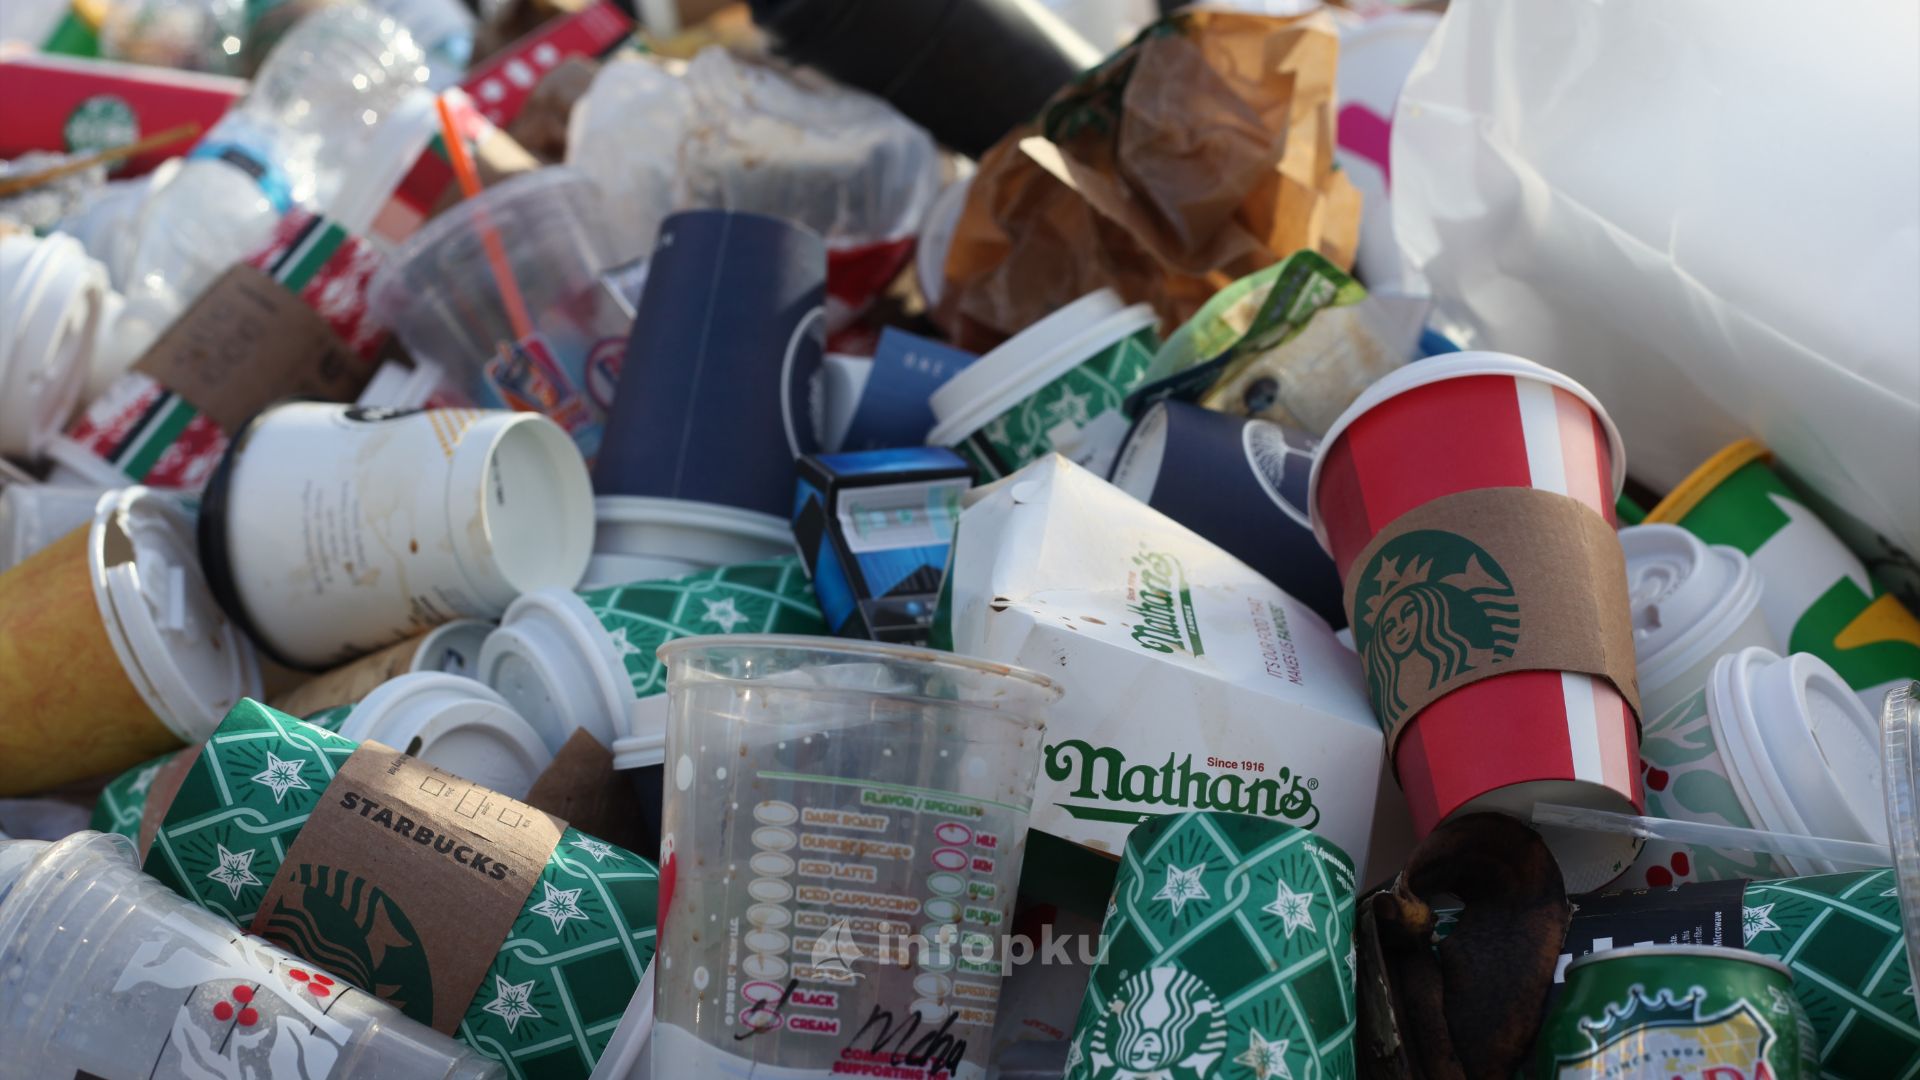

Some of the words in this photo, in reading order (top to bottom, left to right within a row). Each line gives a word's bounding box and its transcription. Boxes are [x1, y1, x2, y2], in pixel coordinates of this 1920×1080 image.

[1283, 654, 1303, 686] MAKES
[1206, 756, 1239, 770] Since
[1241, 760, 1265, 773] 1916
[862, 789, 915, 807] FLAVOR
[803, 810, 839, 824] DARK
[842, 813, 887, 831] ROAST
[800, 863, 832, 877] ICED
[834, 866, 875, 882] LATTE
[799, 888, 830, 902] ICED
[832, 891, 919, 912] CAPPUCCINO
[798, 913, 829, 927] ICED
[1713, 911, 1722, 947] Microwave
[791, 992, 835, 1008] BLACK
[789, 1017, 838, 1034] CREAM
